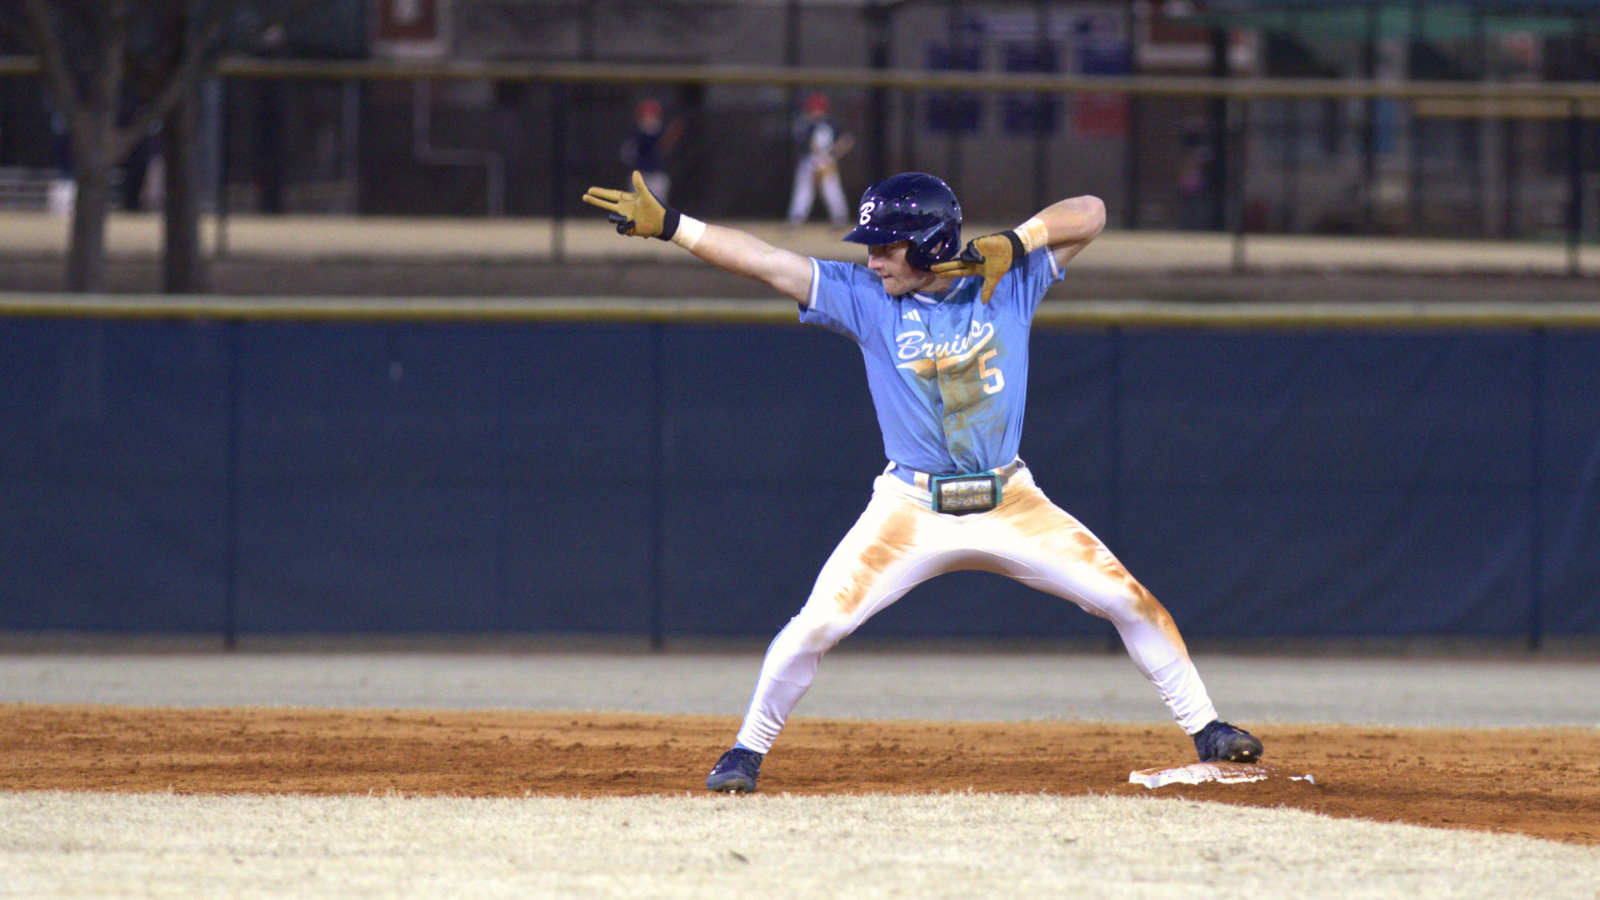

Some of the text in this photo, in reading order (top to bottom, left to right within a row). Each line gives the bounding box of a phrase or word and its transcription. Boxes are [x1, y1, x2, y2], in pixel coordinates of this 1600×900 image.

[859, 202, 875, 225] B
[895, 320, 994, 361] Bruins
[978, 349, 1005, 394] 5
